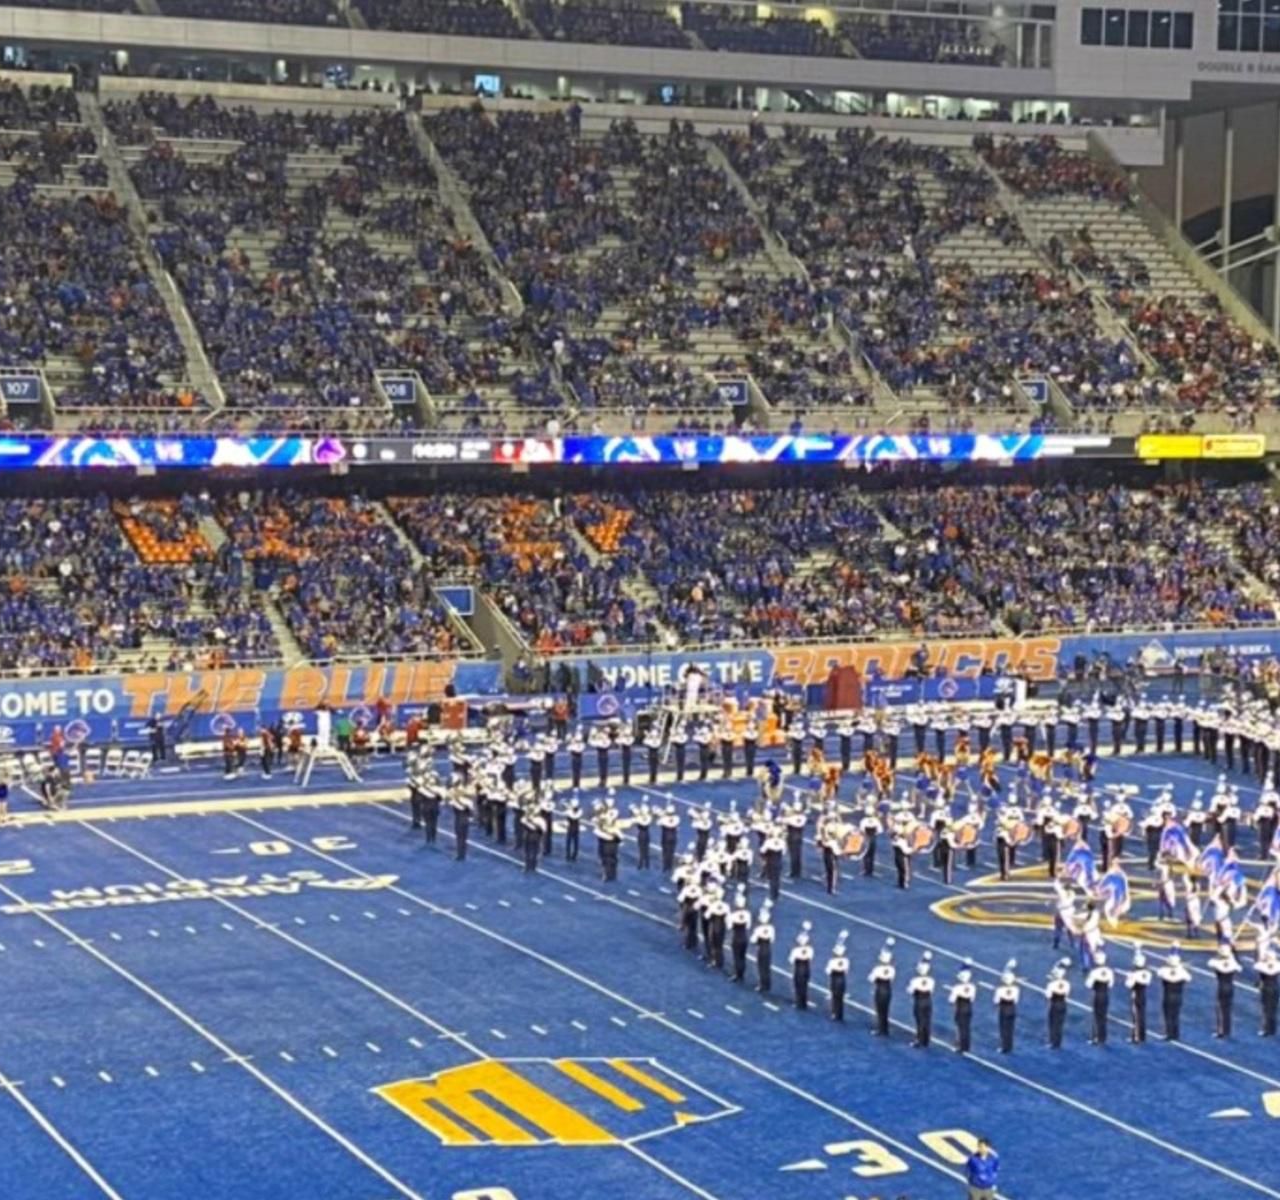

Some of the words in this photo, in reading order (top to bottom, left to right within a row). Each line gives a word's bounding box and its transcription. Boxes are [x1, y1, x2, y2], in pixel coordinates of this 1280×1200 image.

[6, 382, 30, 395] 107
[603, 664, 670, 688] HOME
[716, 660, 762, 683] THE
[75, 689, 115, 714] TO
[123, 671, 266, 717] THE
[280, 661, 456, 709] BLUE
[823, 1129, 999, 1177] 30
